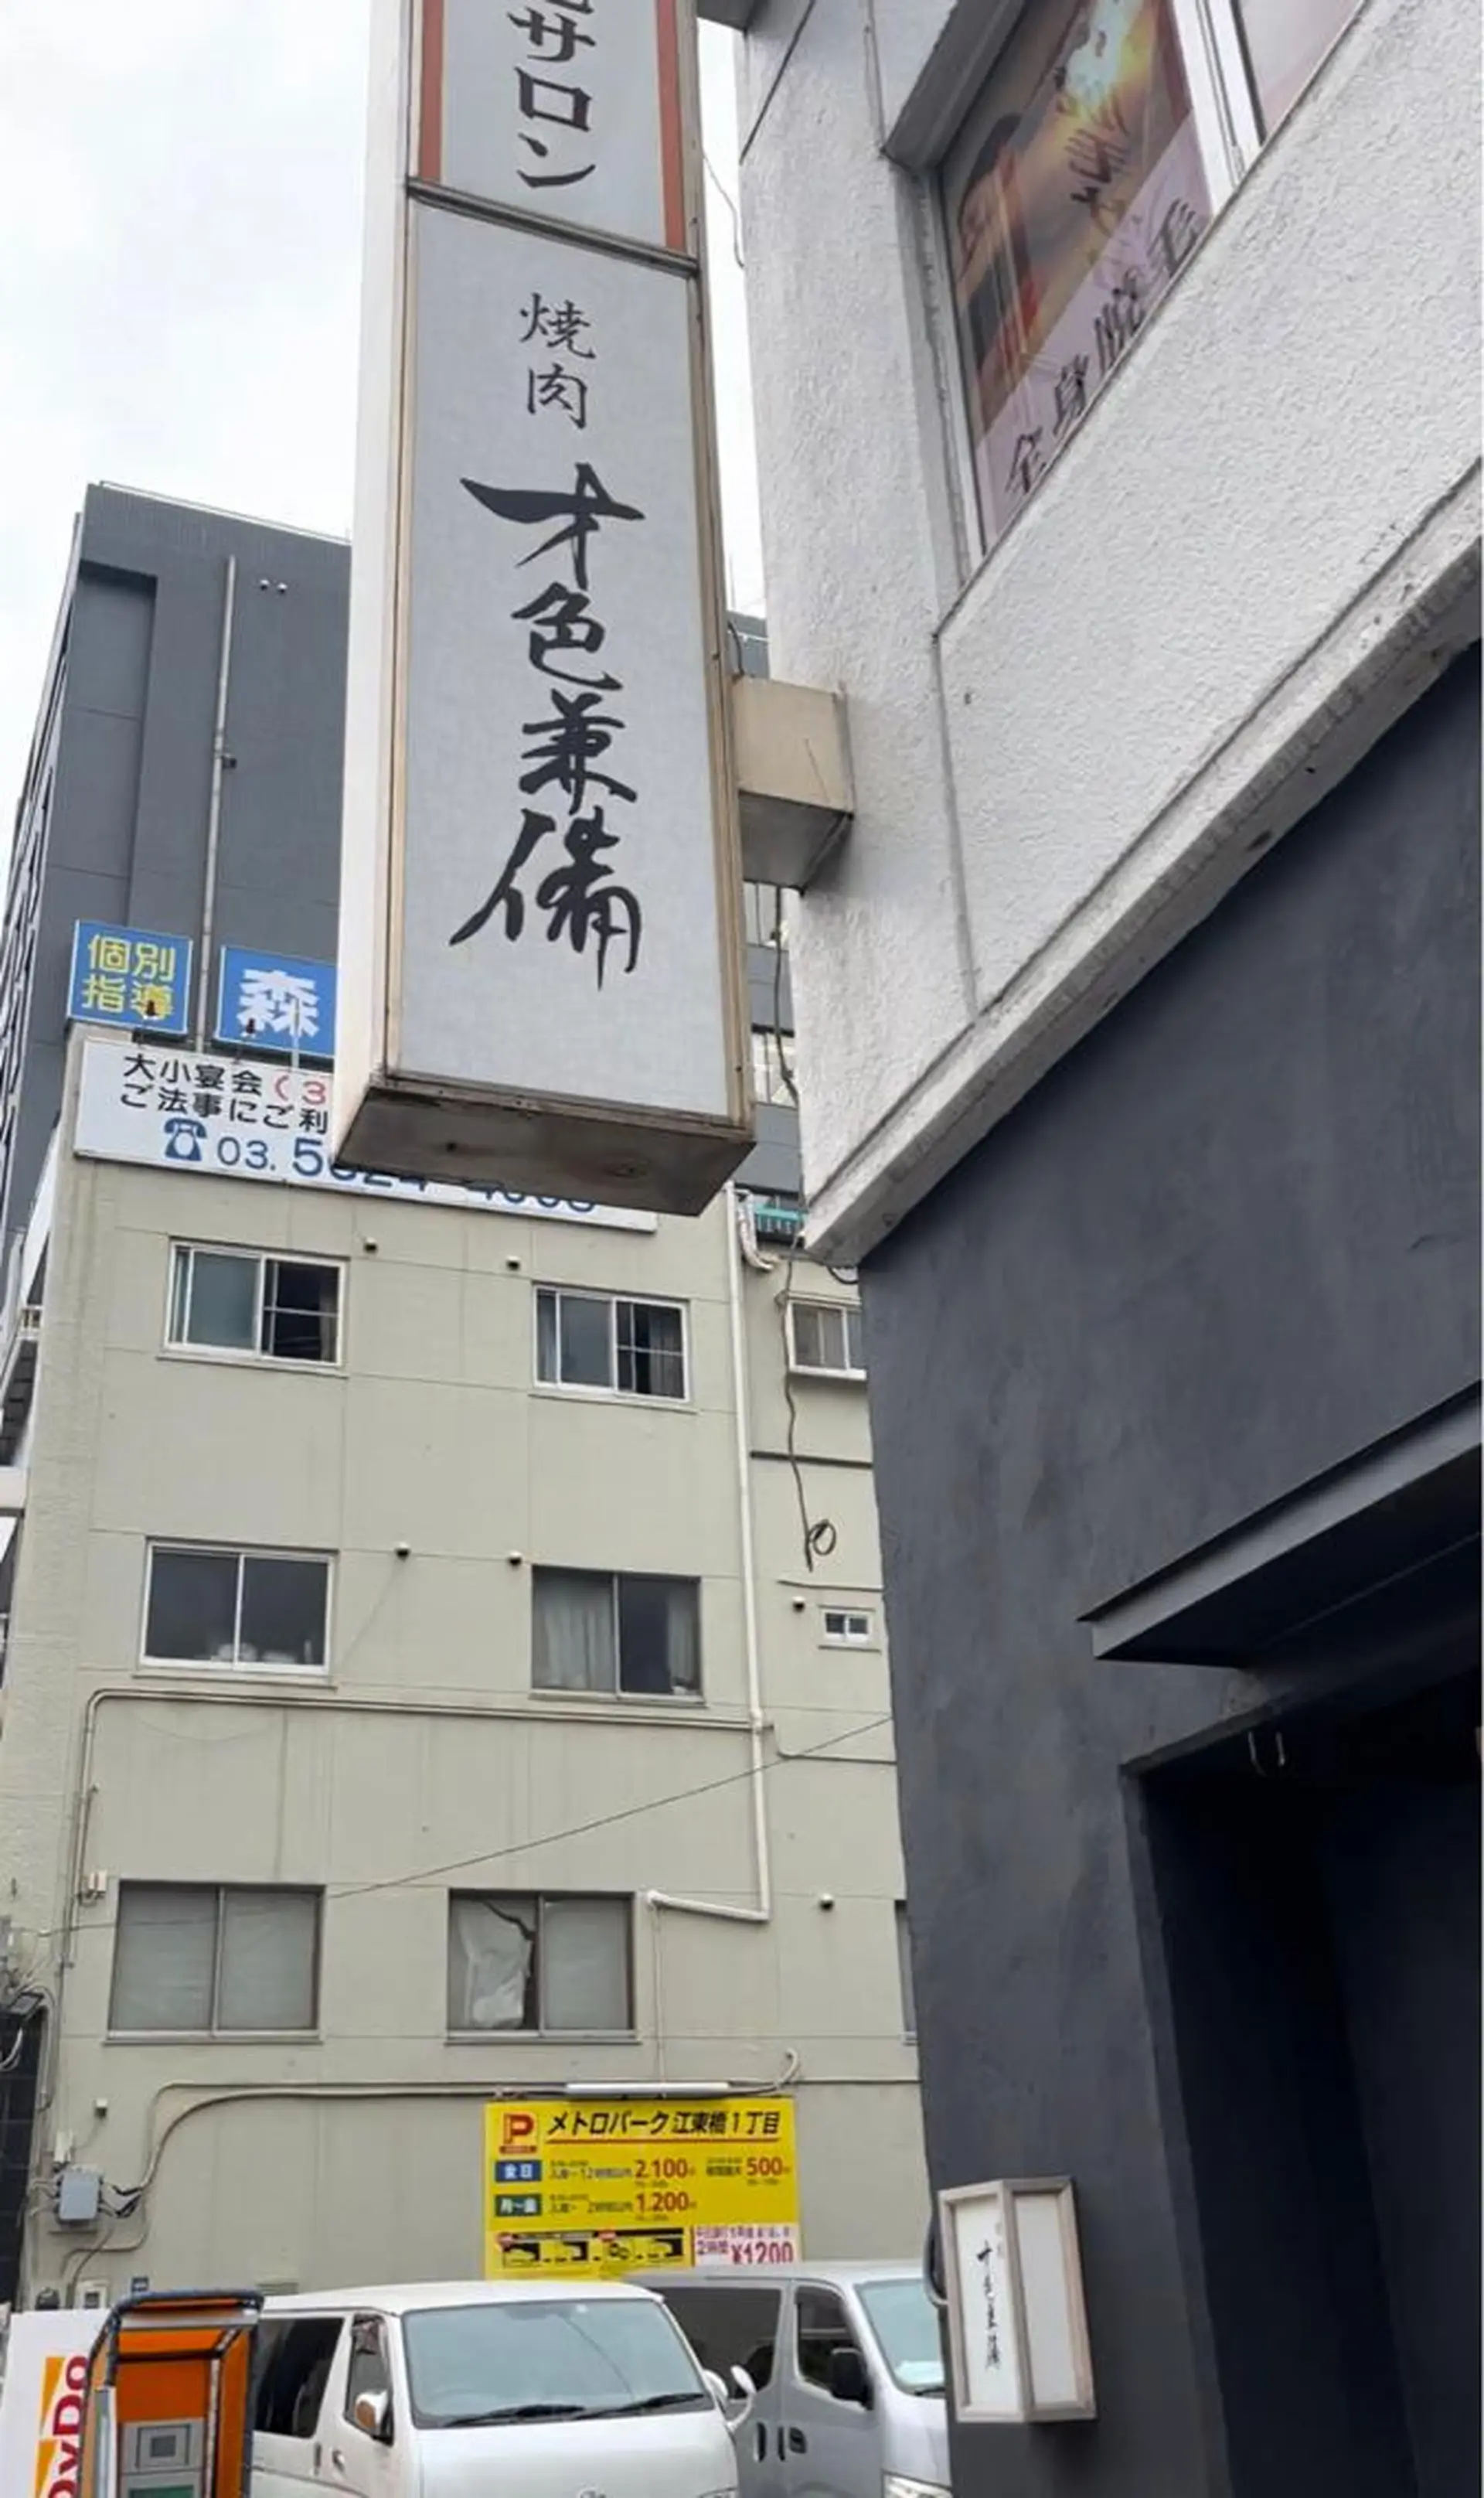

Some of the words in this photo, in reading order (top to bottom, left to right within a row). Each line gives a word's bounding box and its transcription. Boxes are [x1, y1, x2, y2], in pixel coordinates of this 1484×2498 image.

[506, 0, 595, 188] サロン
[519, 291, 596, 430] 焼肉
[449, 462, 645, 991] 才色兼備
[88, 933, 176, 981] 個別
[81, 974, 175, 1021] 指導
[236, 969, 321, 1038] 森
[121, 1082, 328, 1135] ご法事にご利
[503, 2113, 535, 2145] P
